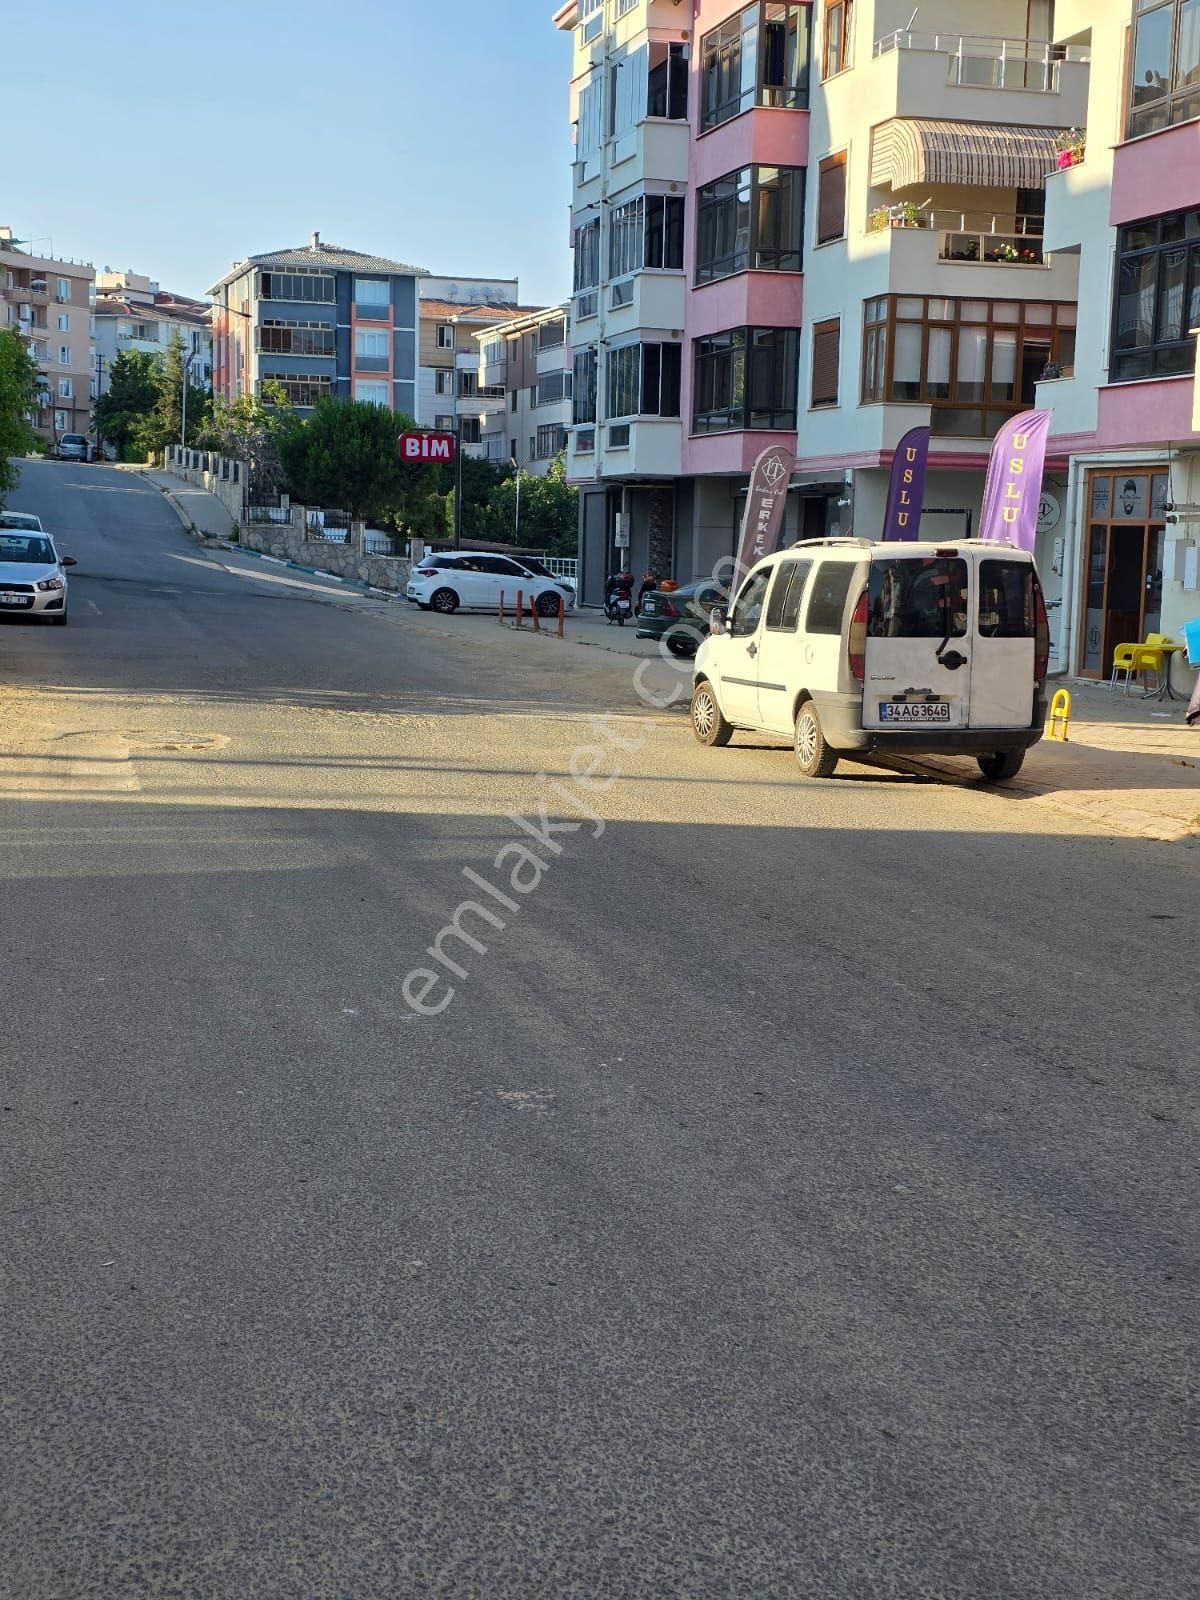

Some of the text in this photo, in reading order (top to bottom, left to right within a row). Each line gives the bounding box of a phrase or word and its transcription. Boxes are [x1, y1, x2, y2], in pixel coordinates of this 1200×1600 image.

[897, 447, 917, 526] USLU
[1003, 434, 1029, 522] USLU
[753, 498, 774, 556] ERKEK
